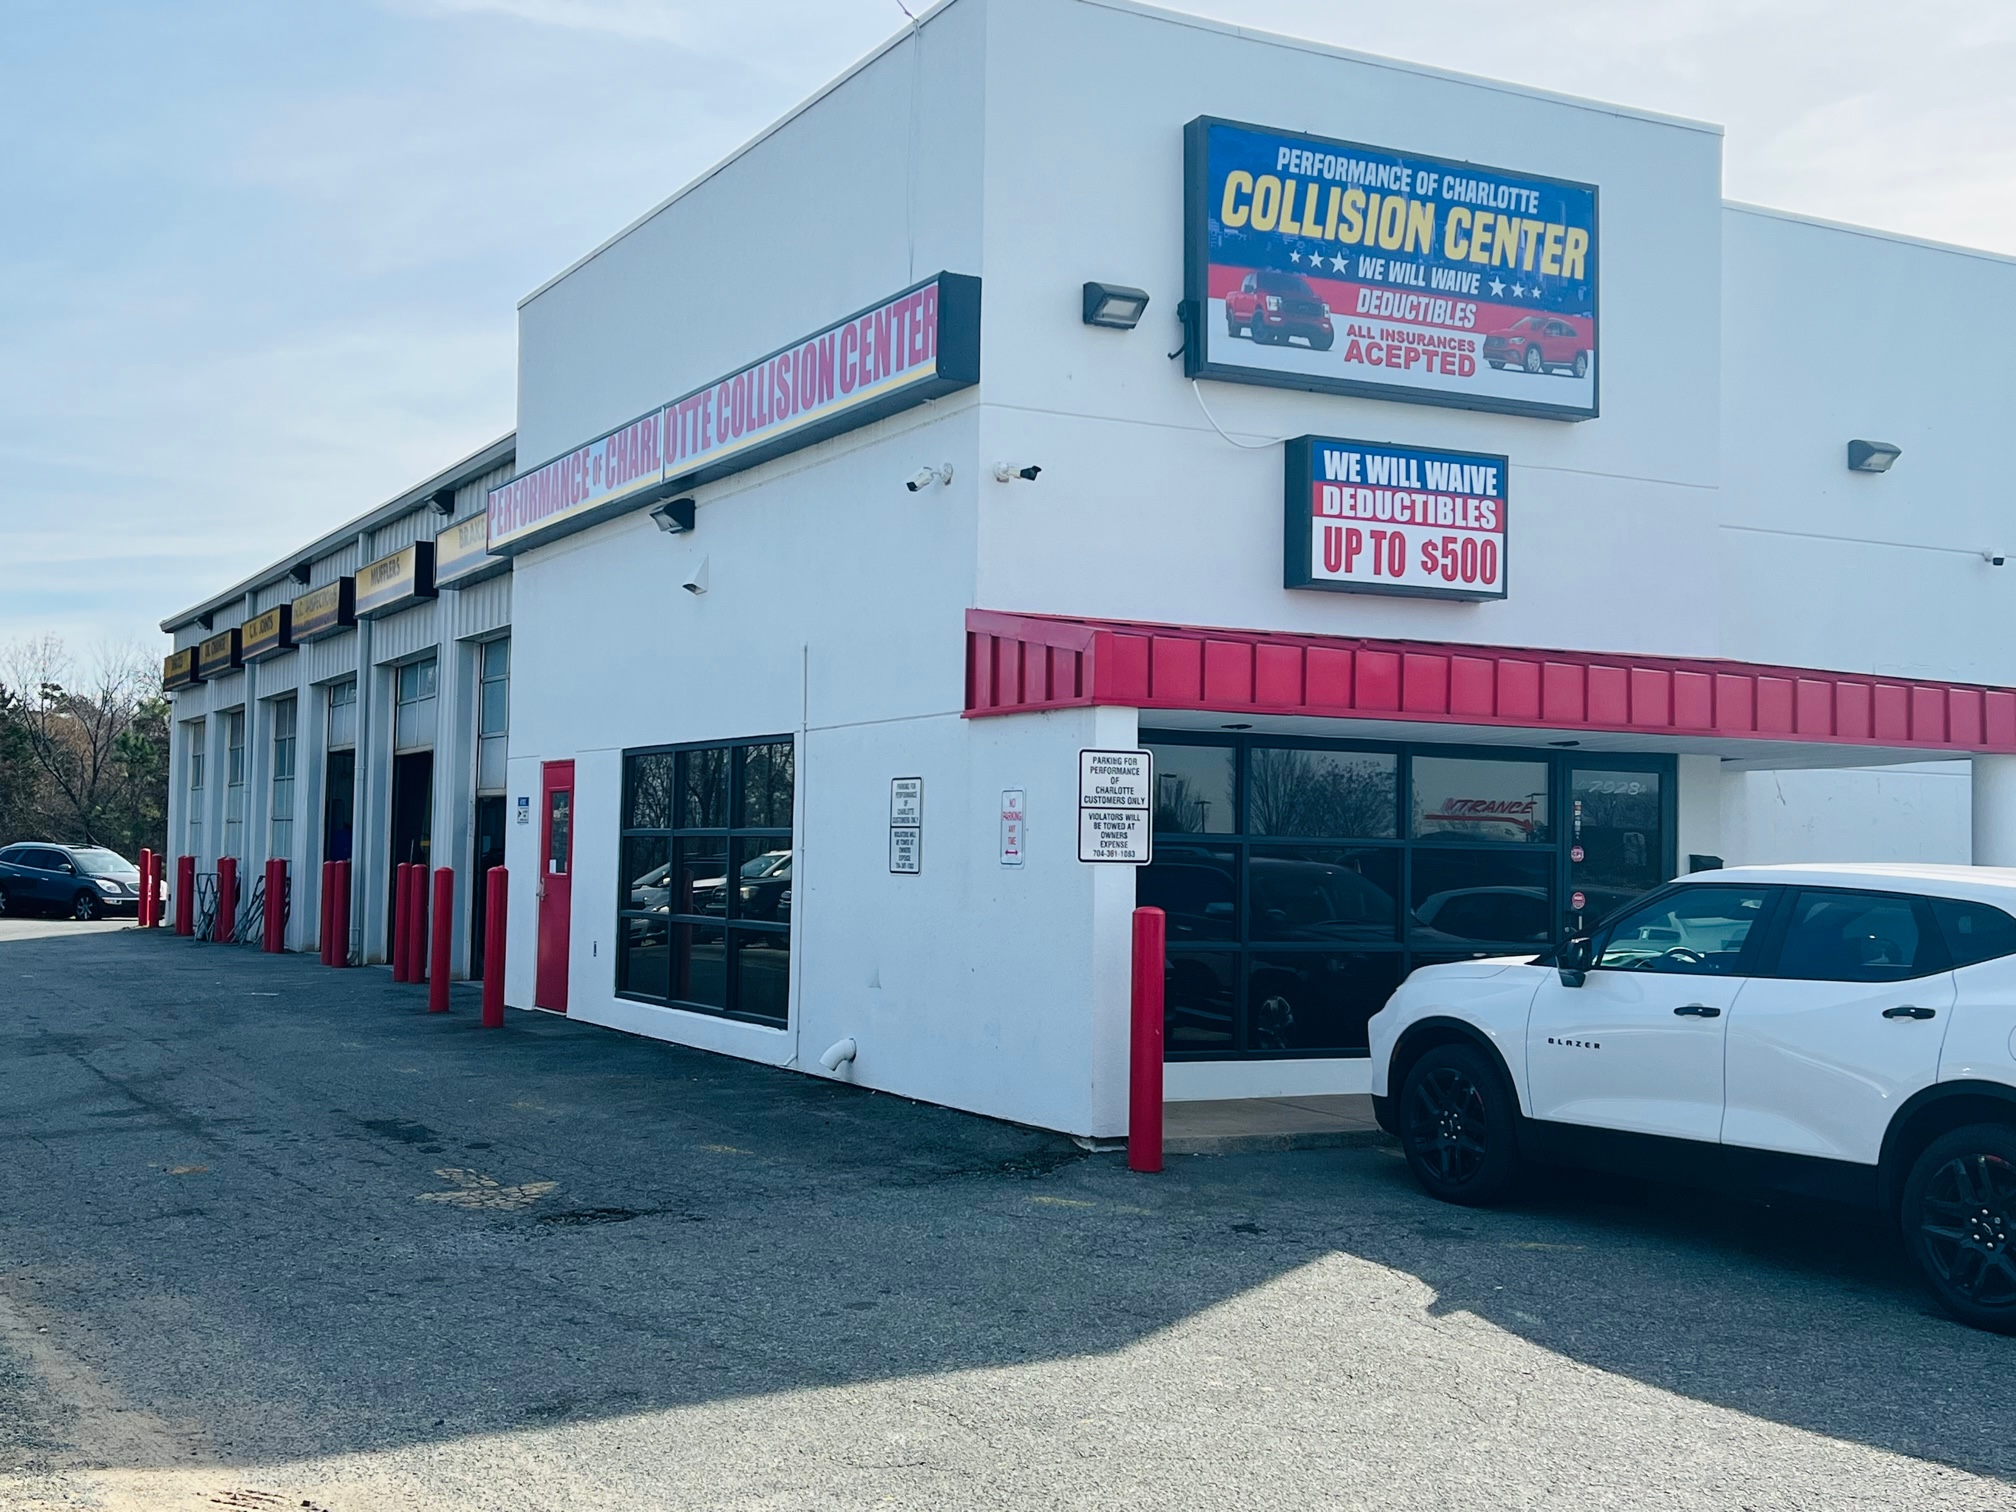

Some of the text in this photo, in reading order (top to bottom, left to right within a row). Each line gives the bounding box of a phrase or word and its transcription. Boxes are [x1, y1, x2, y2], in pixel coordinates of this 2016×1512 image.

[1277, 147, 1540, 214] PERFORMANCE OF CHARLOTTE
[1220, 170, 1589, 280] COLLISION CENTER
[1358, 255, 1481, 295] WE WILL WAIVE
[1356, 288, 1477, 329] DEDUCTIBLES
[1347, 324, 1476, 353] ALL INSURANCES
[1344, 339, 1476, 378] ACEPTED
[488, 285, 939, 541] PERFORMANCE OF CHARLOTTE COLLISION CENTER
[1323, 450, 1498, 496] WE WILL WAIVE
[1322, 485, 1497, 530] DEDUCTIBLES
[1324, 525, 1498, 585] UP TO $500
[370, 556, 400, 587] MUFFLERS
[1092, 756, 1138, 766] PARKING FOR
[1090, 766, 1140, 776] PERFORMANCE
[1110, 776, 1120, 785] OF
[1095, 786, 1134, 795] CHARLOTTE
[1009, 798, 1016, 808] NO
[1084, 795, 1145, 805] CUSTOMERS ONLY
[1002, 811, 1022, 821] PARKING
[1088, 813, 1141, 822] VIOLATORS WILL
[1093, 822, 1101, 830] BE
[1103, 822, 1126, 830] TOWED
[1100, 831, 1128, 839] OWNERS
[1100, 840, 1128, 849] EXPENSE
[1548, 1037, 1600, 1049] BLAZER
